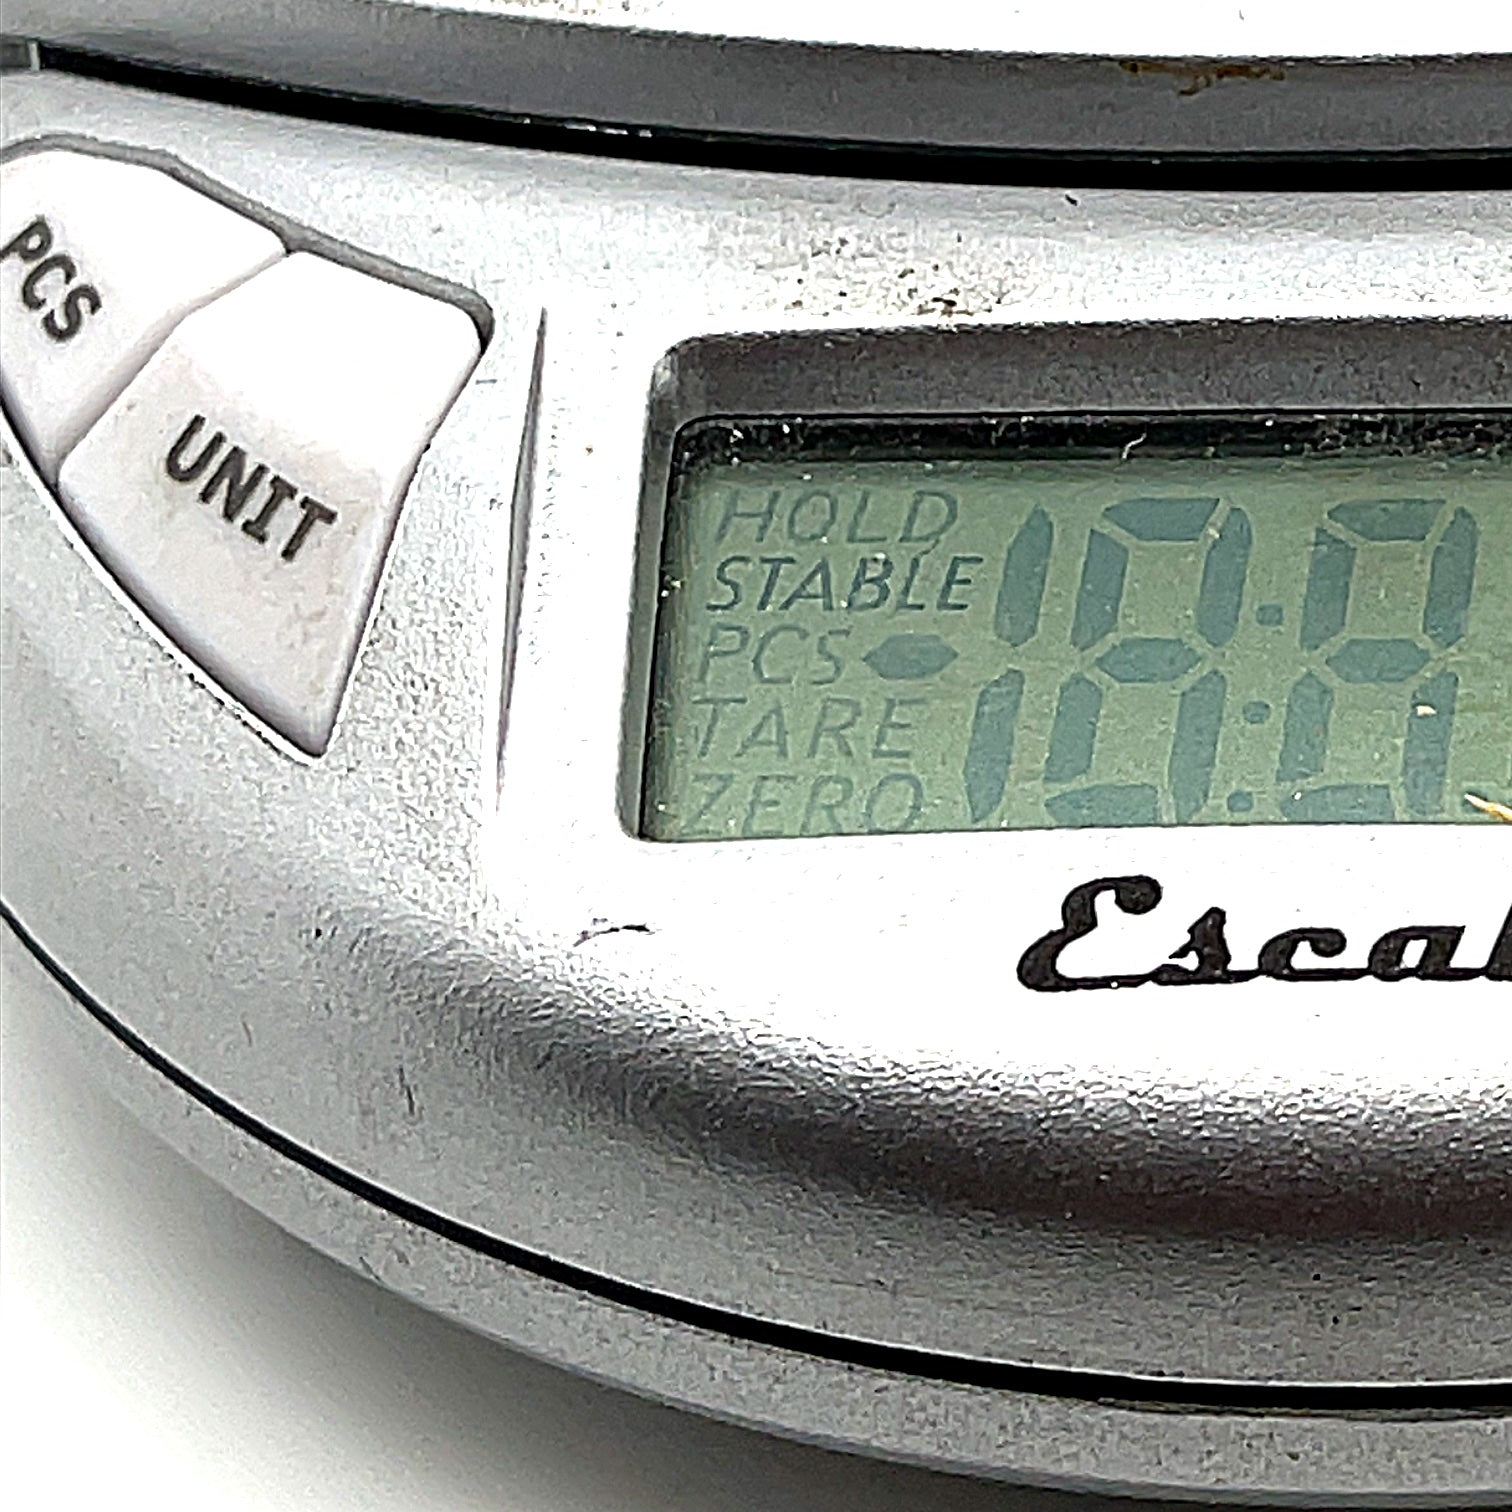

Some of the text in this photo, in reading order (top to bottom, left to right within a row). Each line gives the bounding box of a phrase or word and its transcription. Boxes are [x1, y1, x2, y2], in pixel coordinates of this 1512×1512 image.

[0, 215, 102, 342] PCS
[165, 414, 338, 562] UNIT
[714, 490, 958, 544] HOLD
[706, 555, 983, 611] STABLE
[697, 624, 851, 685] PCS
[690, 696, 926, 759] TARE
[684, 772, 924, 836] ZERO
